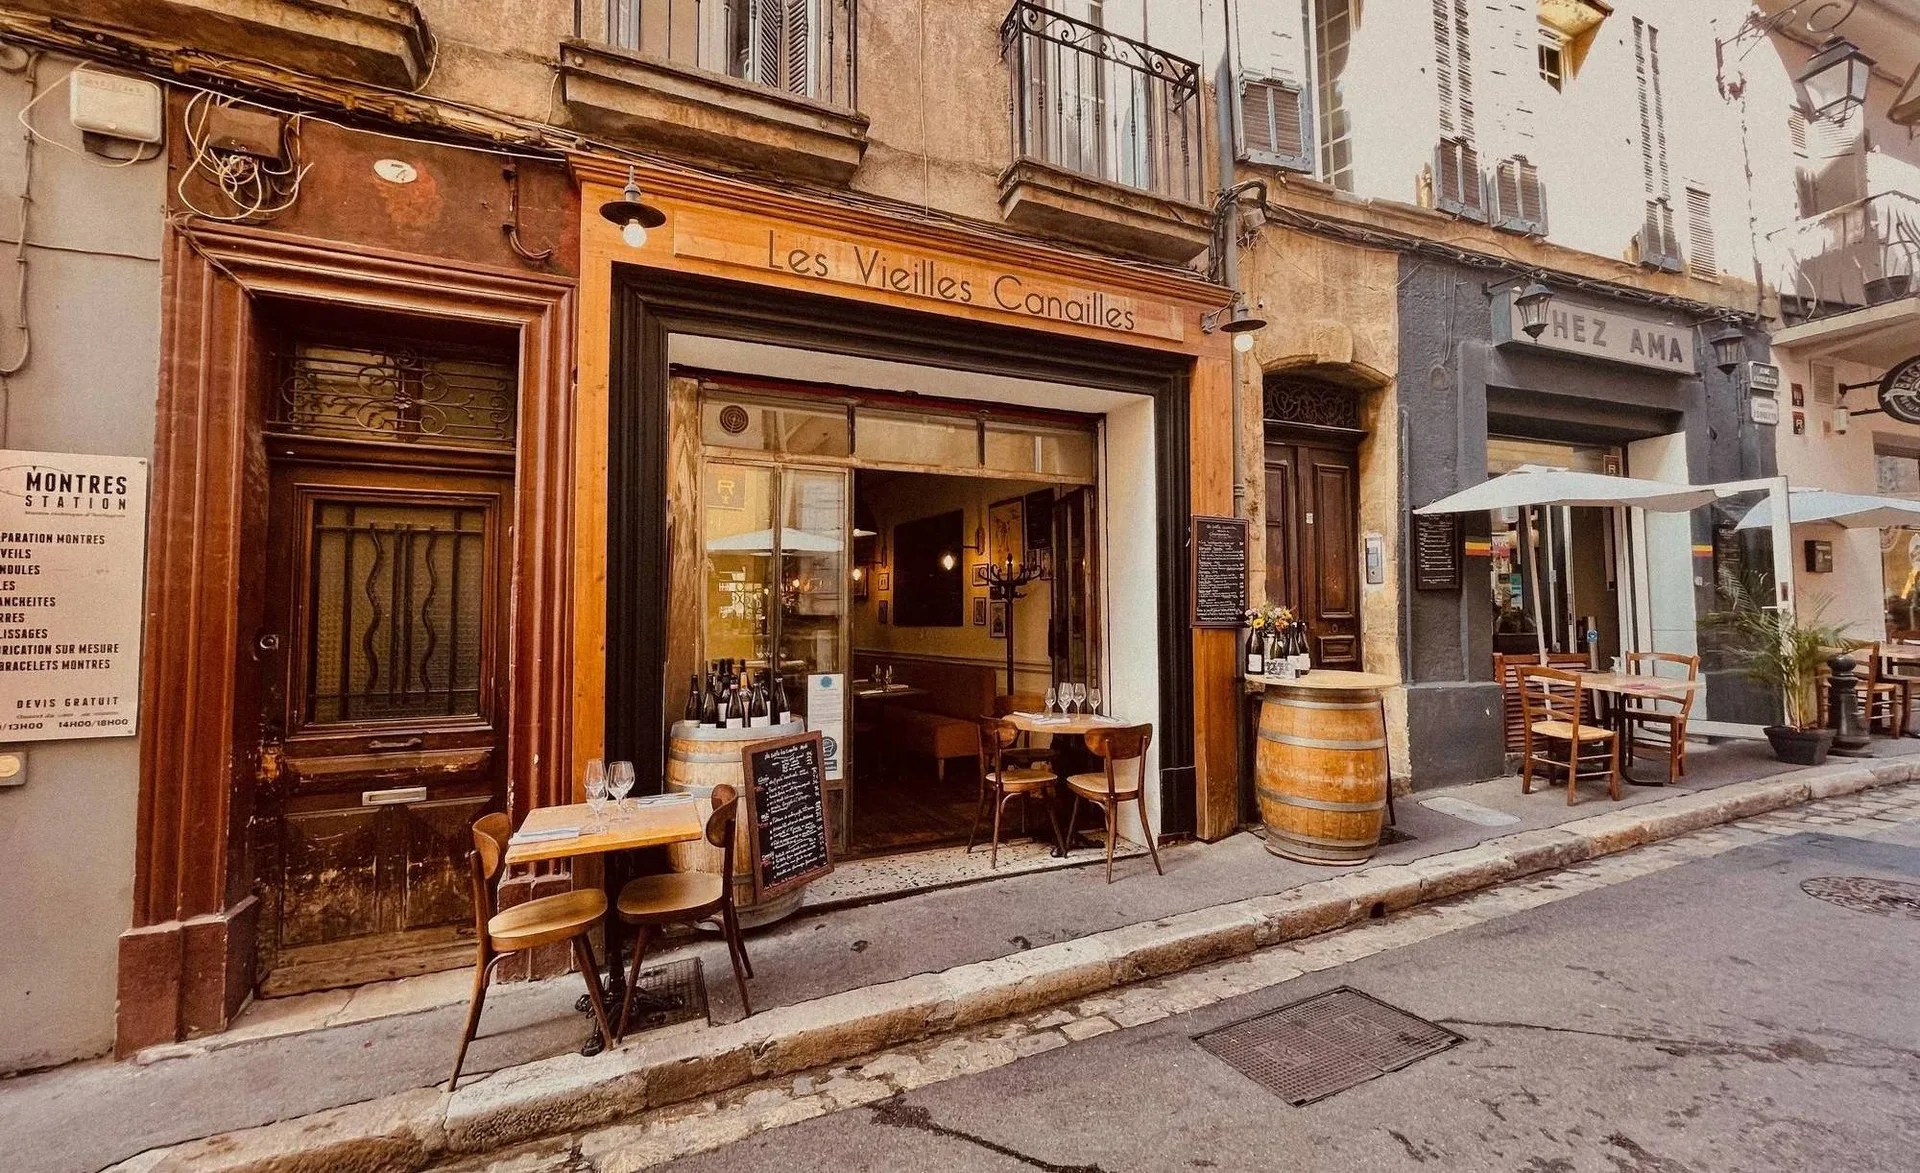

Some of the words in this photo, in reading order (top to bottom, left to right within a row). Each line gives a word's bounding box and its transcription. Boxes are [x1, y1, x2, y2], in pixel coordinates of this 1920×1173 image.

[769, 229, 830, 277] Les
[853, 245, 972, 303] Vieilles
[994, 275, 1135, 331] Canailles
[1552, 309, 1607, 347] HEZ
[1630, 328, 1683, 363] AMA
[26, 471, 127, 495] MONTRES
[25, 495, 126, 510] STATION
[56, 534, 106, 545] MONTRES
[0, 644, 52, 656] RICATION
[55, 644, 76, 654] SUR
[79, 643, 120, 654] MESURE
[0, 660, 58, 671] BRACELETS
[62, 659, 111, 670] MONTRES
[17, 698, 56, 709] DEVIS
[64, 696, 119, 707] GRATUIT
